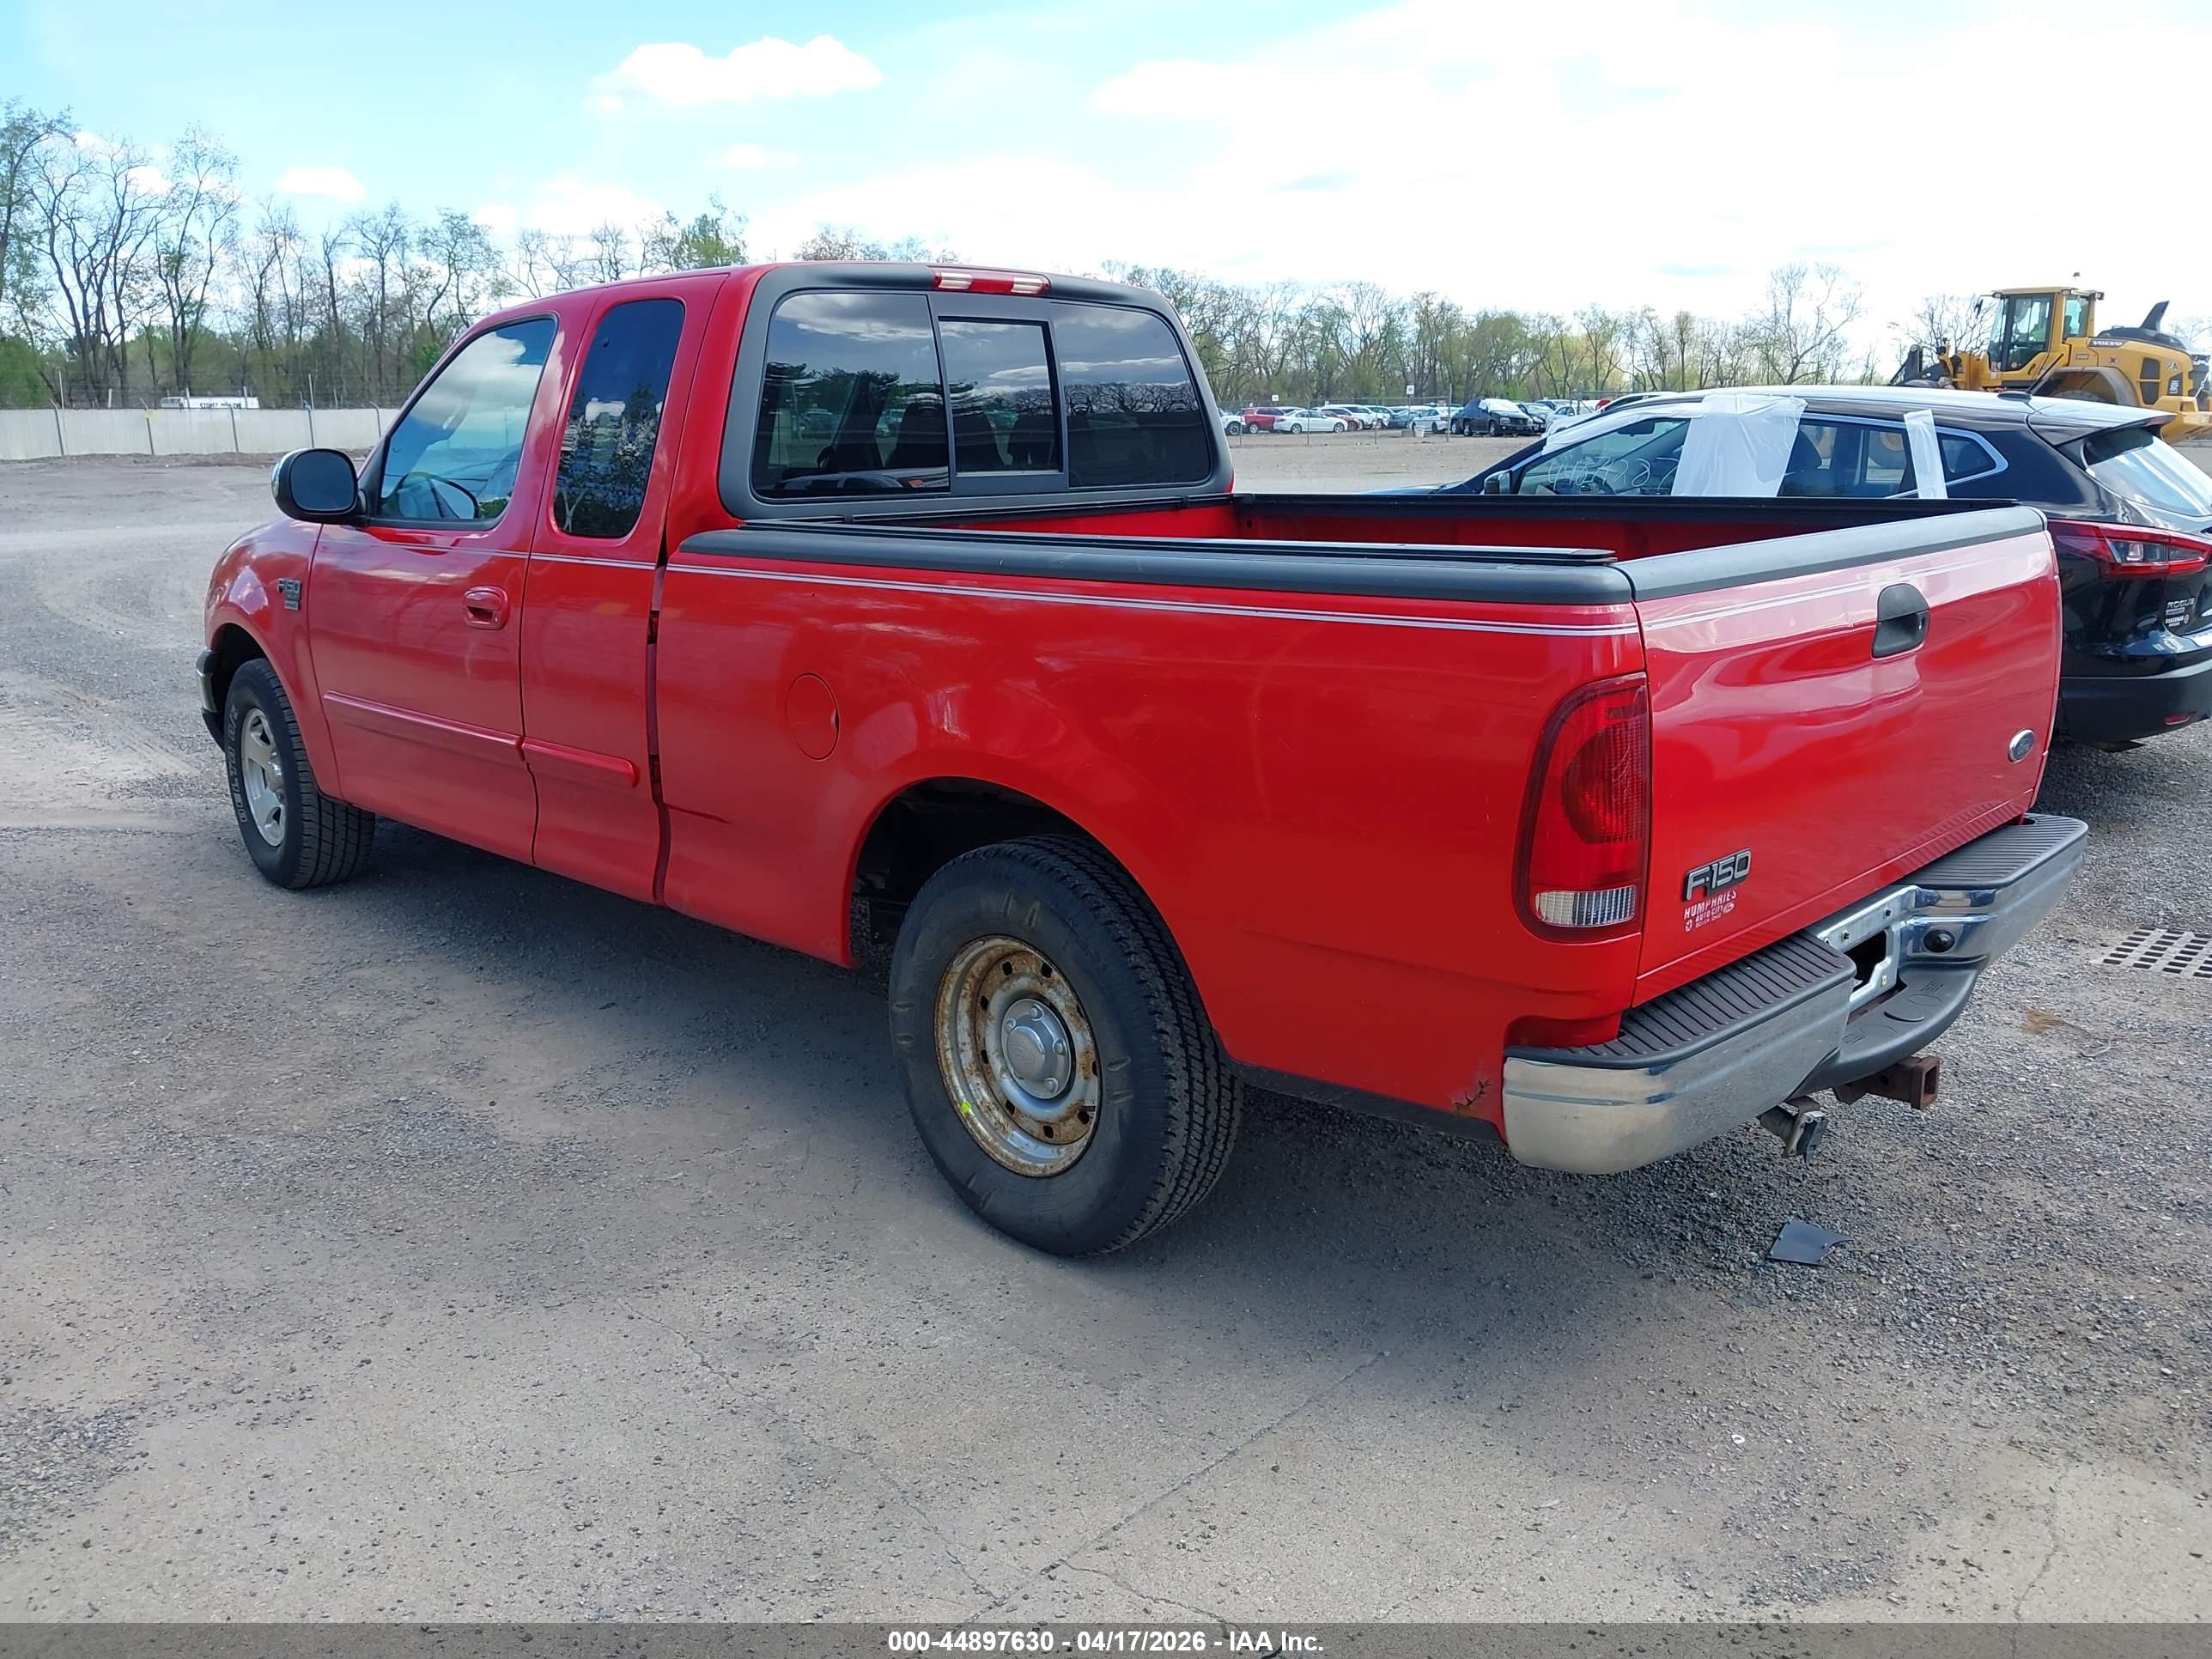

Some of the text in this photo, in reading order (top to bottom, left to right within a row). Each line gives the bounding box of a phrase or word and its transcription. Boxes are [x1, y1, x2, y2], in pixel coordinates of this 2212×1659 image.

[2166, 597, 2196, 609] ROGUE
[1683, 889, 1737, 921] HUMPHRIES
[1695, 909, 1711, 923] AUTO
[1711, 905, 1724, 916] CITY
